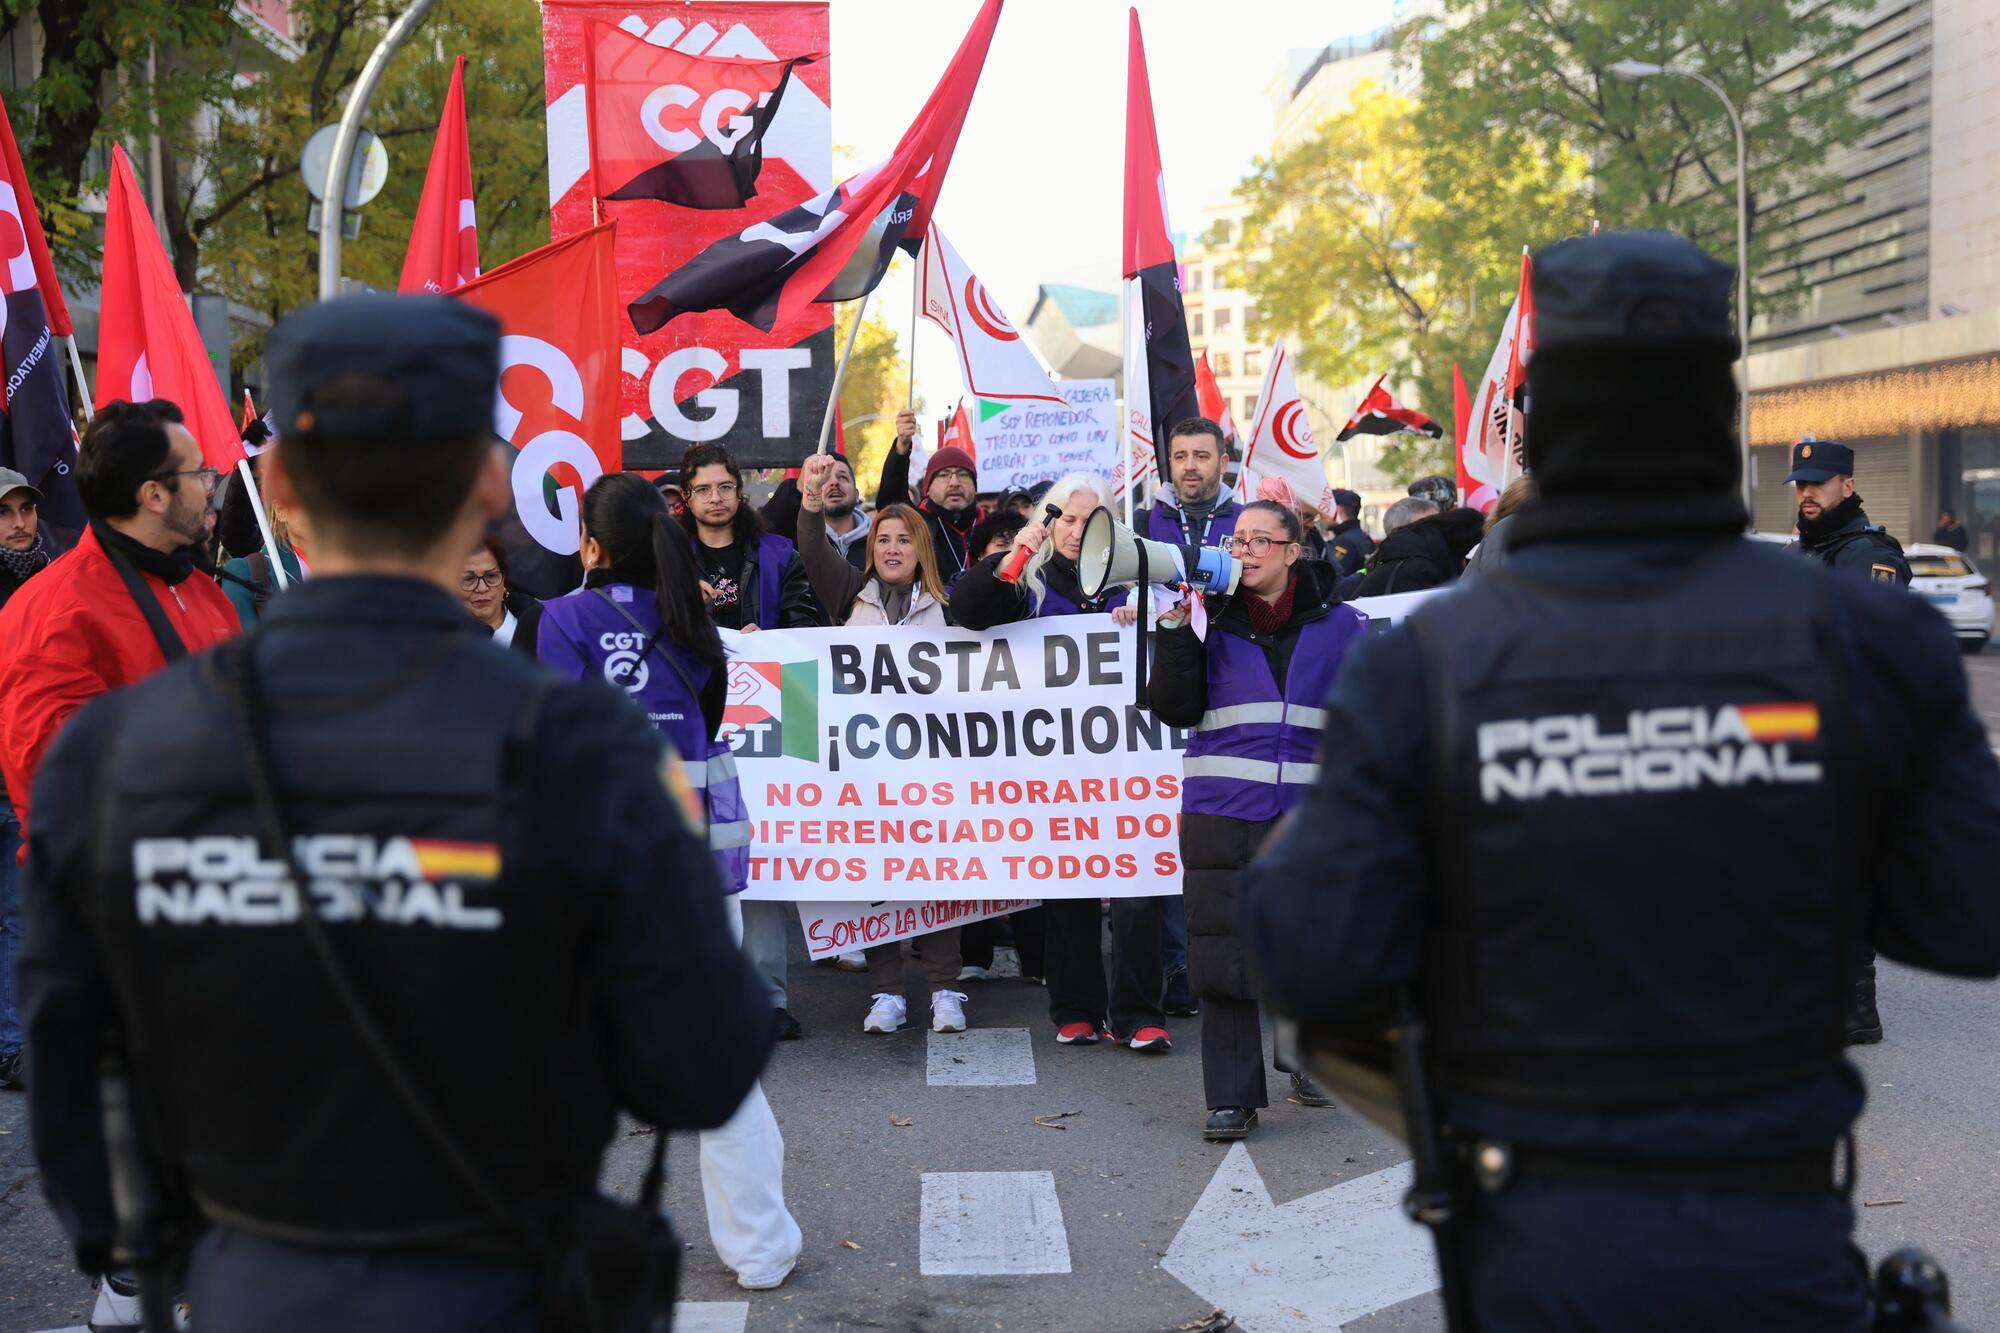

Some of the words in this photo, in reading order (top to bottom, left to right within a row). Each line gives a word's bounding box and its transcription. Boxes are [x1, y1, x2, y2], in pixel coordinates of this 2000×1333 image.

[600, 632, 646, 651] CGT
[830, 638, 1021, 695] BASTA
[1043, 631, 1123, 688] DE
[648, 712, 684, 720] Nuestra
[1477, 705, 1752, 762] POLICIA
[829, 705, 1188, 772] ¡CONDICION
[766, 783, 822, 806] NO
[837, 783, 862, 806] A
[878, 782, 954, 806] LOS
[970, 775, 1179, 805] HORARIOS
[1479, 742, 1823, 803] NACIONAL
[749, 818, 1033, 844] IFERENCIADO
[1049, 817, 1099, 841] EN
[1116, 813, 1182, 839] DO
[883, 856, 988, 881] PARA
[1002, 853, 1138, 880] TODOS
[136, 881, 503, 928] NACIONAL
[809, 912, 890, 953] SOMOS
[895, 909, 917, 936] LA
